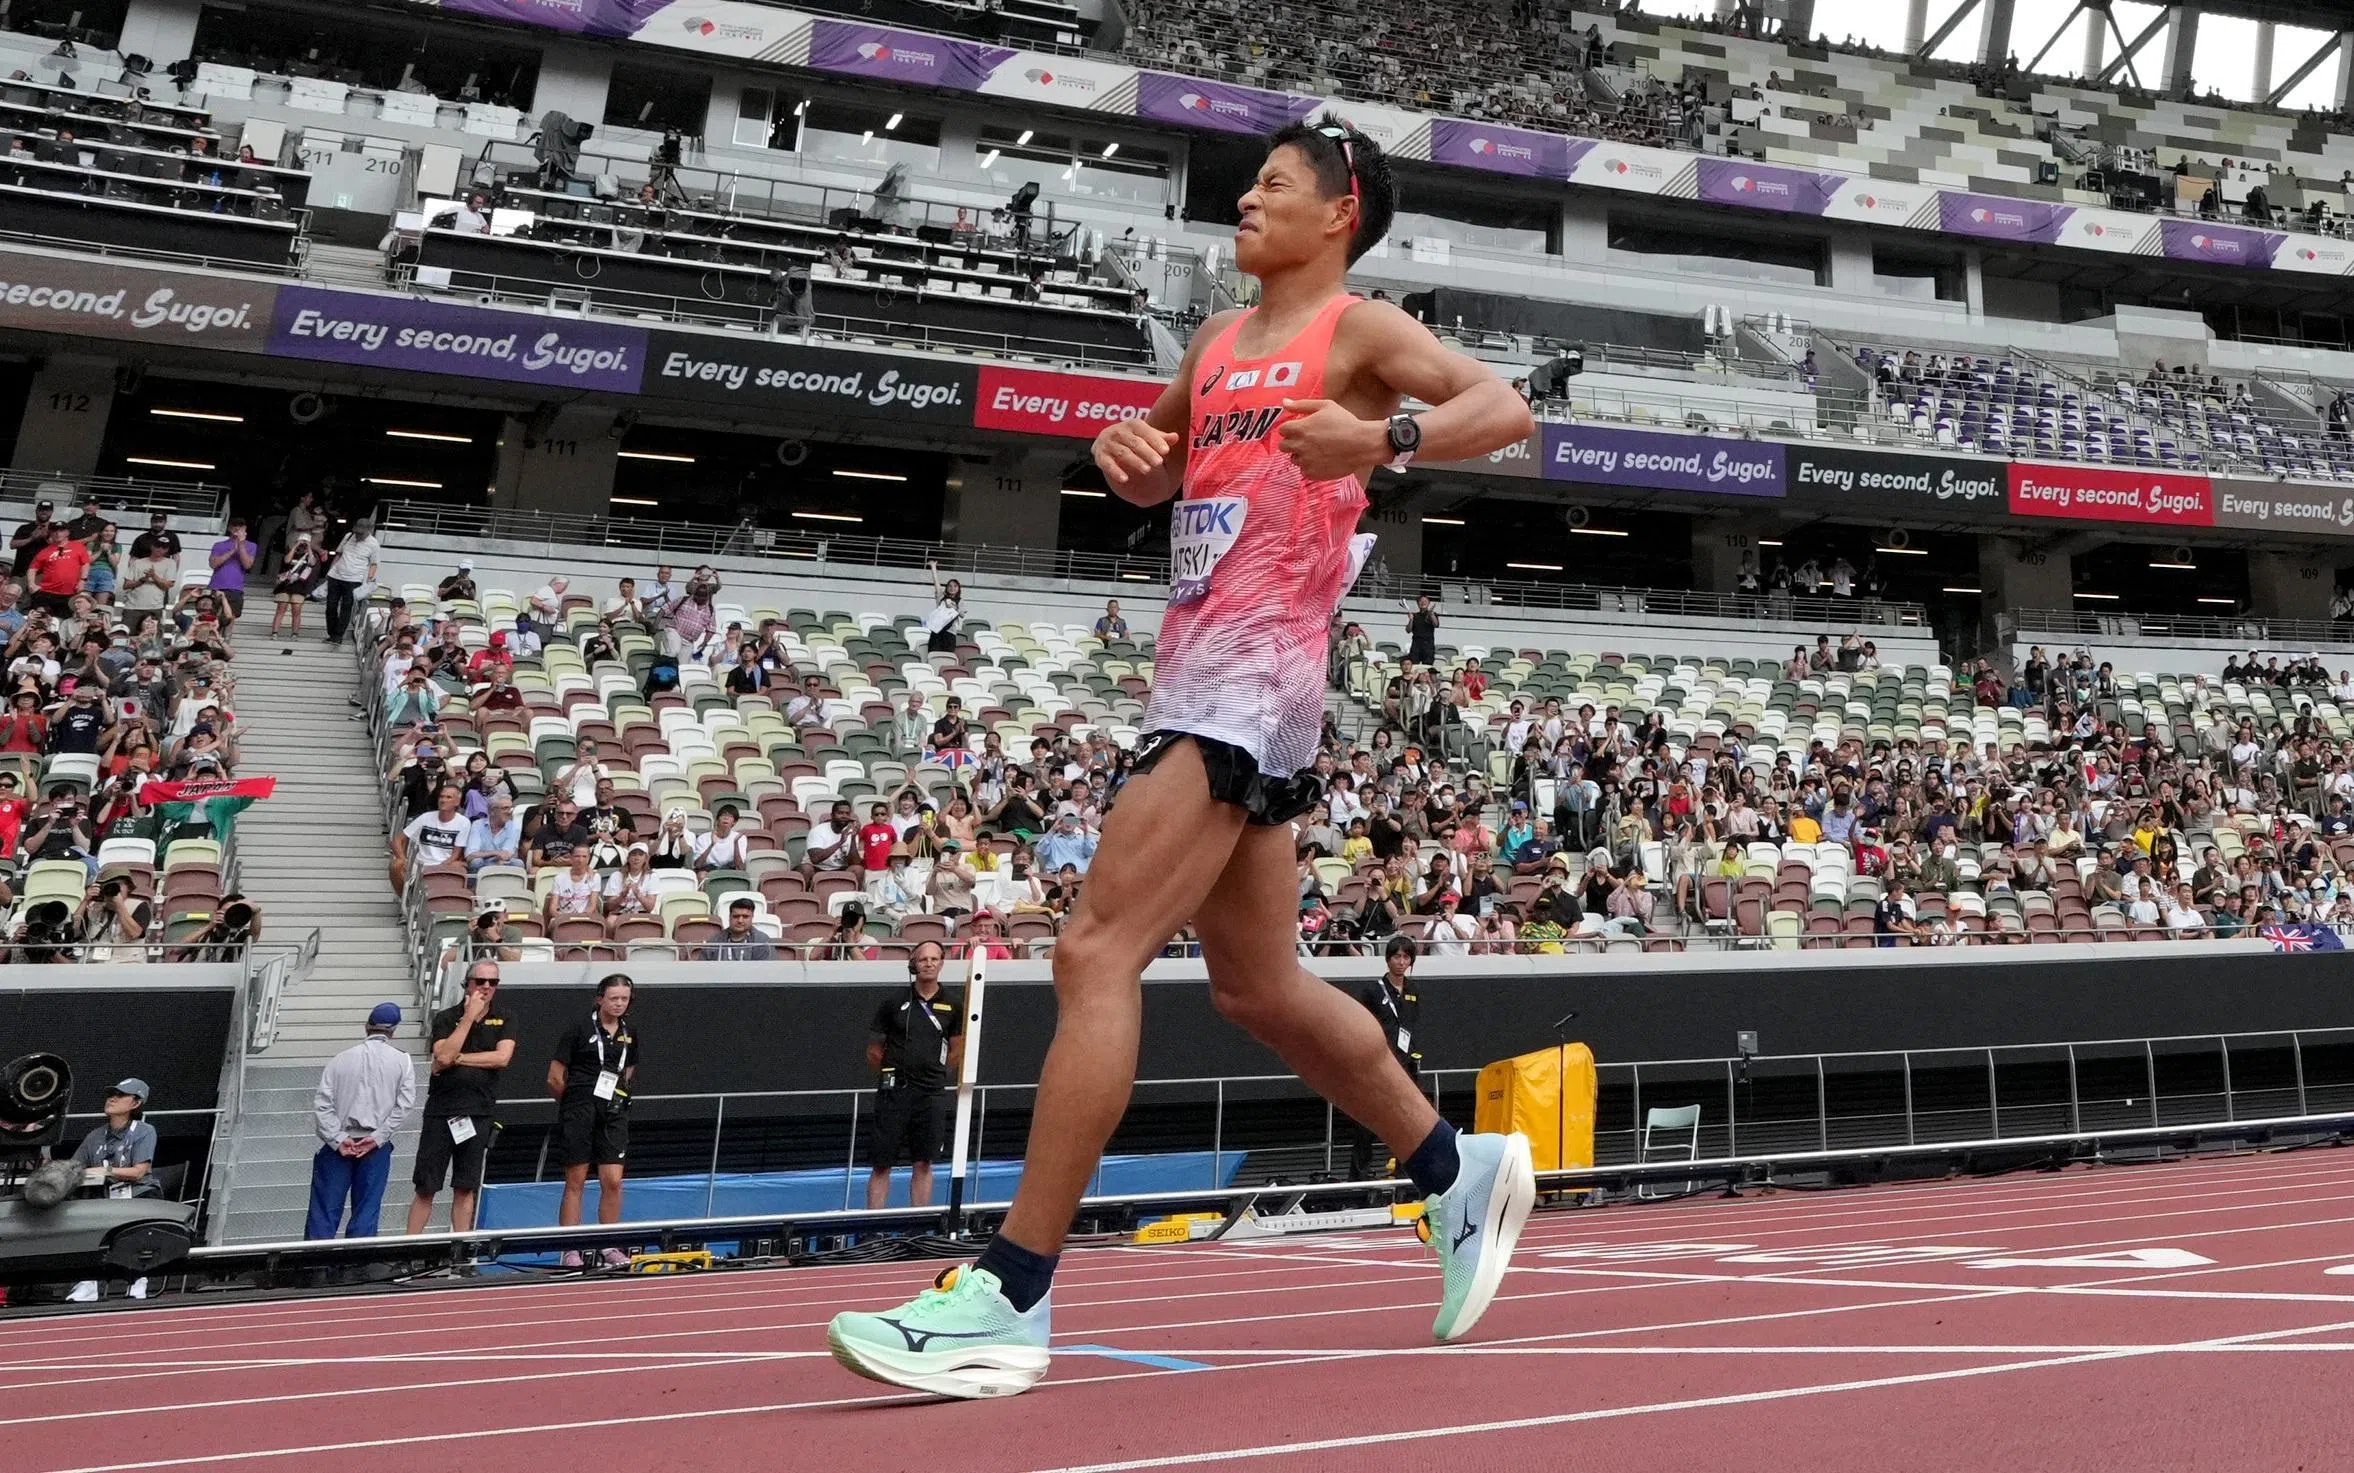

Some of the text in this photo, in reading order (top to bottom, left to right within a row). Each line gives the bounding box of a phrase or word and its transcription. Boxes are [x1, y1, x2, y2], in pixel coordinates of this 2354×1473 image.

[301, 149, 333, 165] 211
[365, 158, 400, 175] 210
[1165, 264, 1191, 277] 209
[131, 288, 251, 332] Sugoi.
[289, 309, 628, 374] Every second, Sugoi.
[1789, 337, 1811, 348] 208
[661, 352, 962, 409] Every second, Sugoi.
[50, 393, 90, 412] 112
[992, 386, 1151, 422] Every secon
[1193, 406, 1283, 449] JAPAN
[544, 439, 577, 456] 111
[1555, 441, 1776, 483] Every second, Sugoi.
[995, 476, 1021, 492] 111
[1798, 462, 1999, 500] Every second, Sugoi.
[2019, 479, 2204, 514] Every second, Sugoi.
[2222, 493, 2270, 520] Every
[2274, 500, 2336, 521] second,
[1183, 502, 1238, 535] TDK
[1383, 510, 1408, 524] 110
[1147, 1227, 1186, 1238] SEIKO
